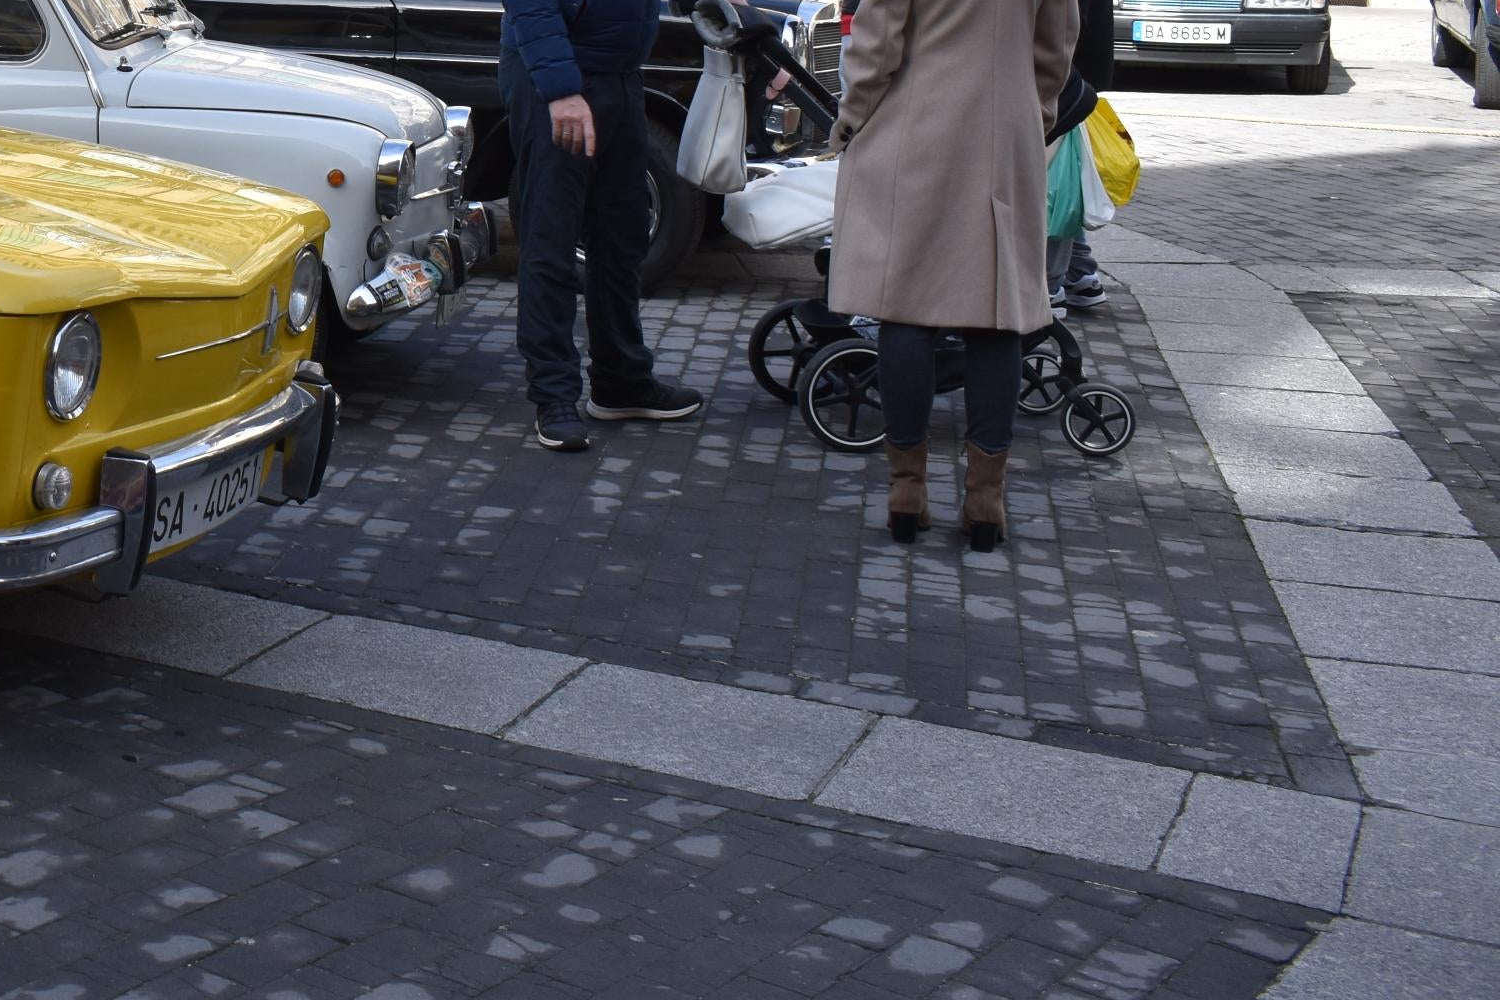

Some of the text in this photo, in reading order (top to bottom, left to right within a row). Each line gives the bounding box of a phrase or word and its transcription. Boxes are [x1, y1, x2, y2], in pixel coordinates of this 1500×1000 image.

[1145, 25, 1226, 41] BA 8685 M
[153, 455, 259, 542] SA 40251
